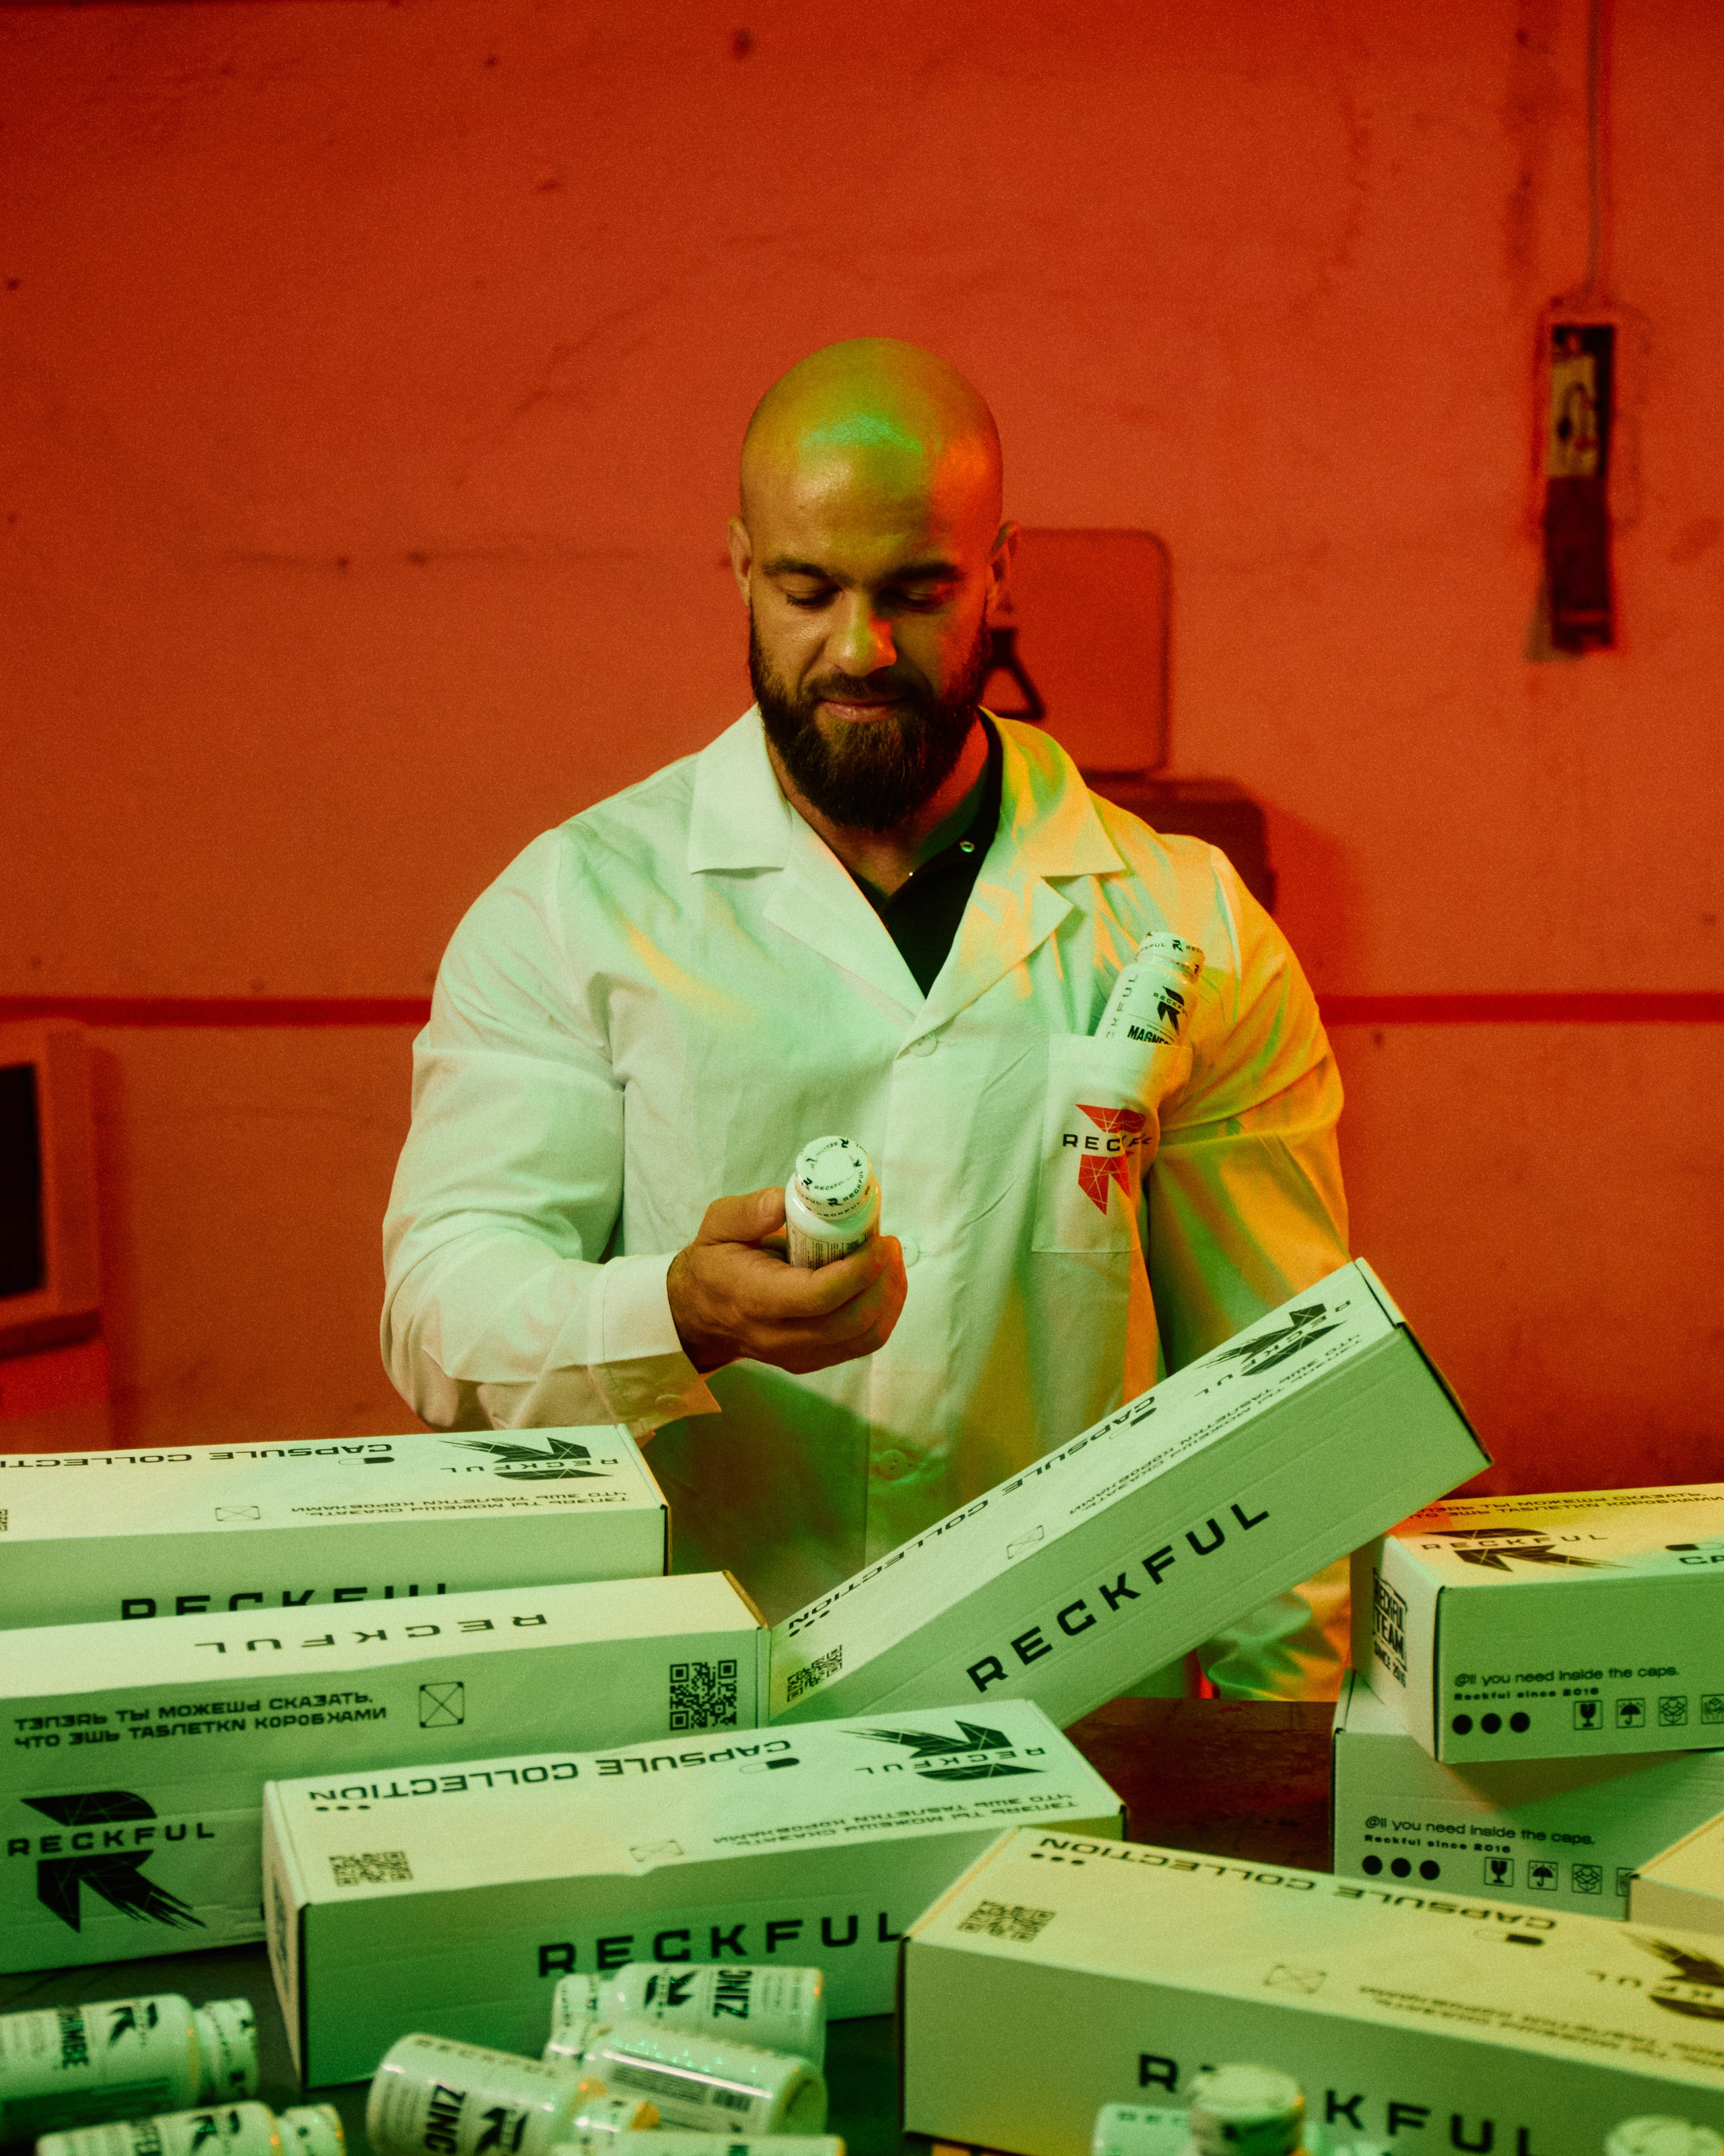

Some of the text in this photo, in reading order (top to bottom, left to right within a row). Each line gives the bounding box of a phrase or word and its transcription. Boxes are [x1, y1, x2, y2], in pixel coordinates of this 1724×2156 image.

[209, 1443, 393, 1460] CAPSULE
[440, 1458, 618, 1473] RECKFUL
[789, 1396, 1156, 1631] CAPSULE COLLECTION
[1421, 1534, 1608, 1551] RECKFUL
[966, 1503, 1269, 1693] RECKFUL
[194, 1613, 548, 1654] RECKFUL
[1374, 1606, 1404, 1662] TEAM
[1455, 1691, 1511, 1700] Reckful
[1517, 1689, 1556, 1699] since
[1482, 1674, 1511, 1687] you
[1515, 1670, 1554, 1683] need
[1559, 1669, 1603, 1681] inside
[1608, 1666, 1633, 1678] the
[1638, 1666, 1680, 1678] caps.
[308, 1739, 793, 1803] CAPSULE COLLECTION
[855, 1747, 1047, 1774] RECKFUL
[7, 1822, 216, 1857] RECKFUL
[1364, 1834, 1421, 1846] Reckful
[1428, 1840, 1467, 1850] since
[1392, 1819, 1422, 1831] you
[1426, 1820, 1466, 1835] need
[1471, 1825, 1516, 1838] inside
[1521, 1829, 1547, 1842] the
[1551, 1830, 1595, 1846] caps.
[1038, 1836, 1558, 1931] CAPSULE COLLECTION
[539, 1912, 901, 1978] RECKFUL
[713, 1969, 753, 2018] ZINC
[425, 2084, 467, 2155] ZINC
